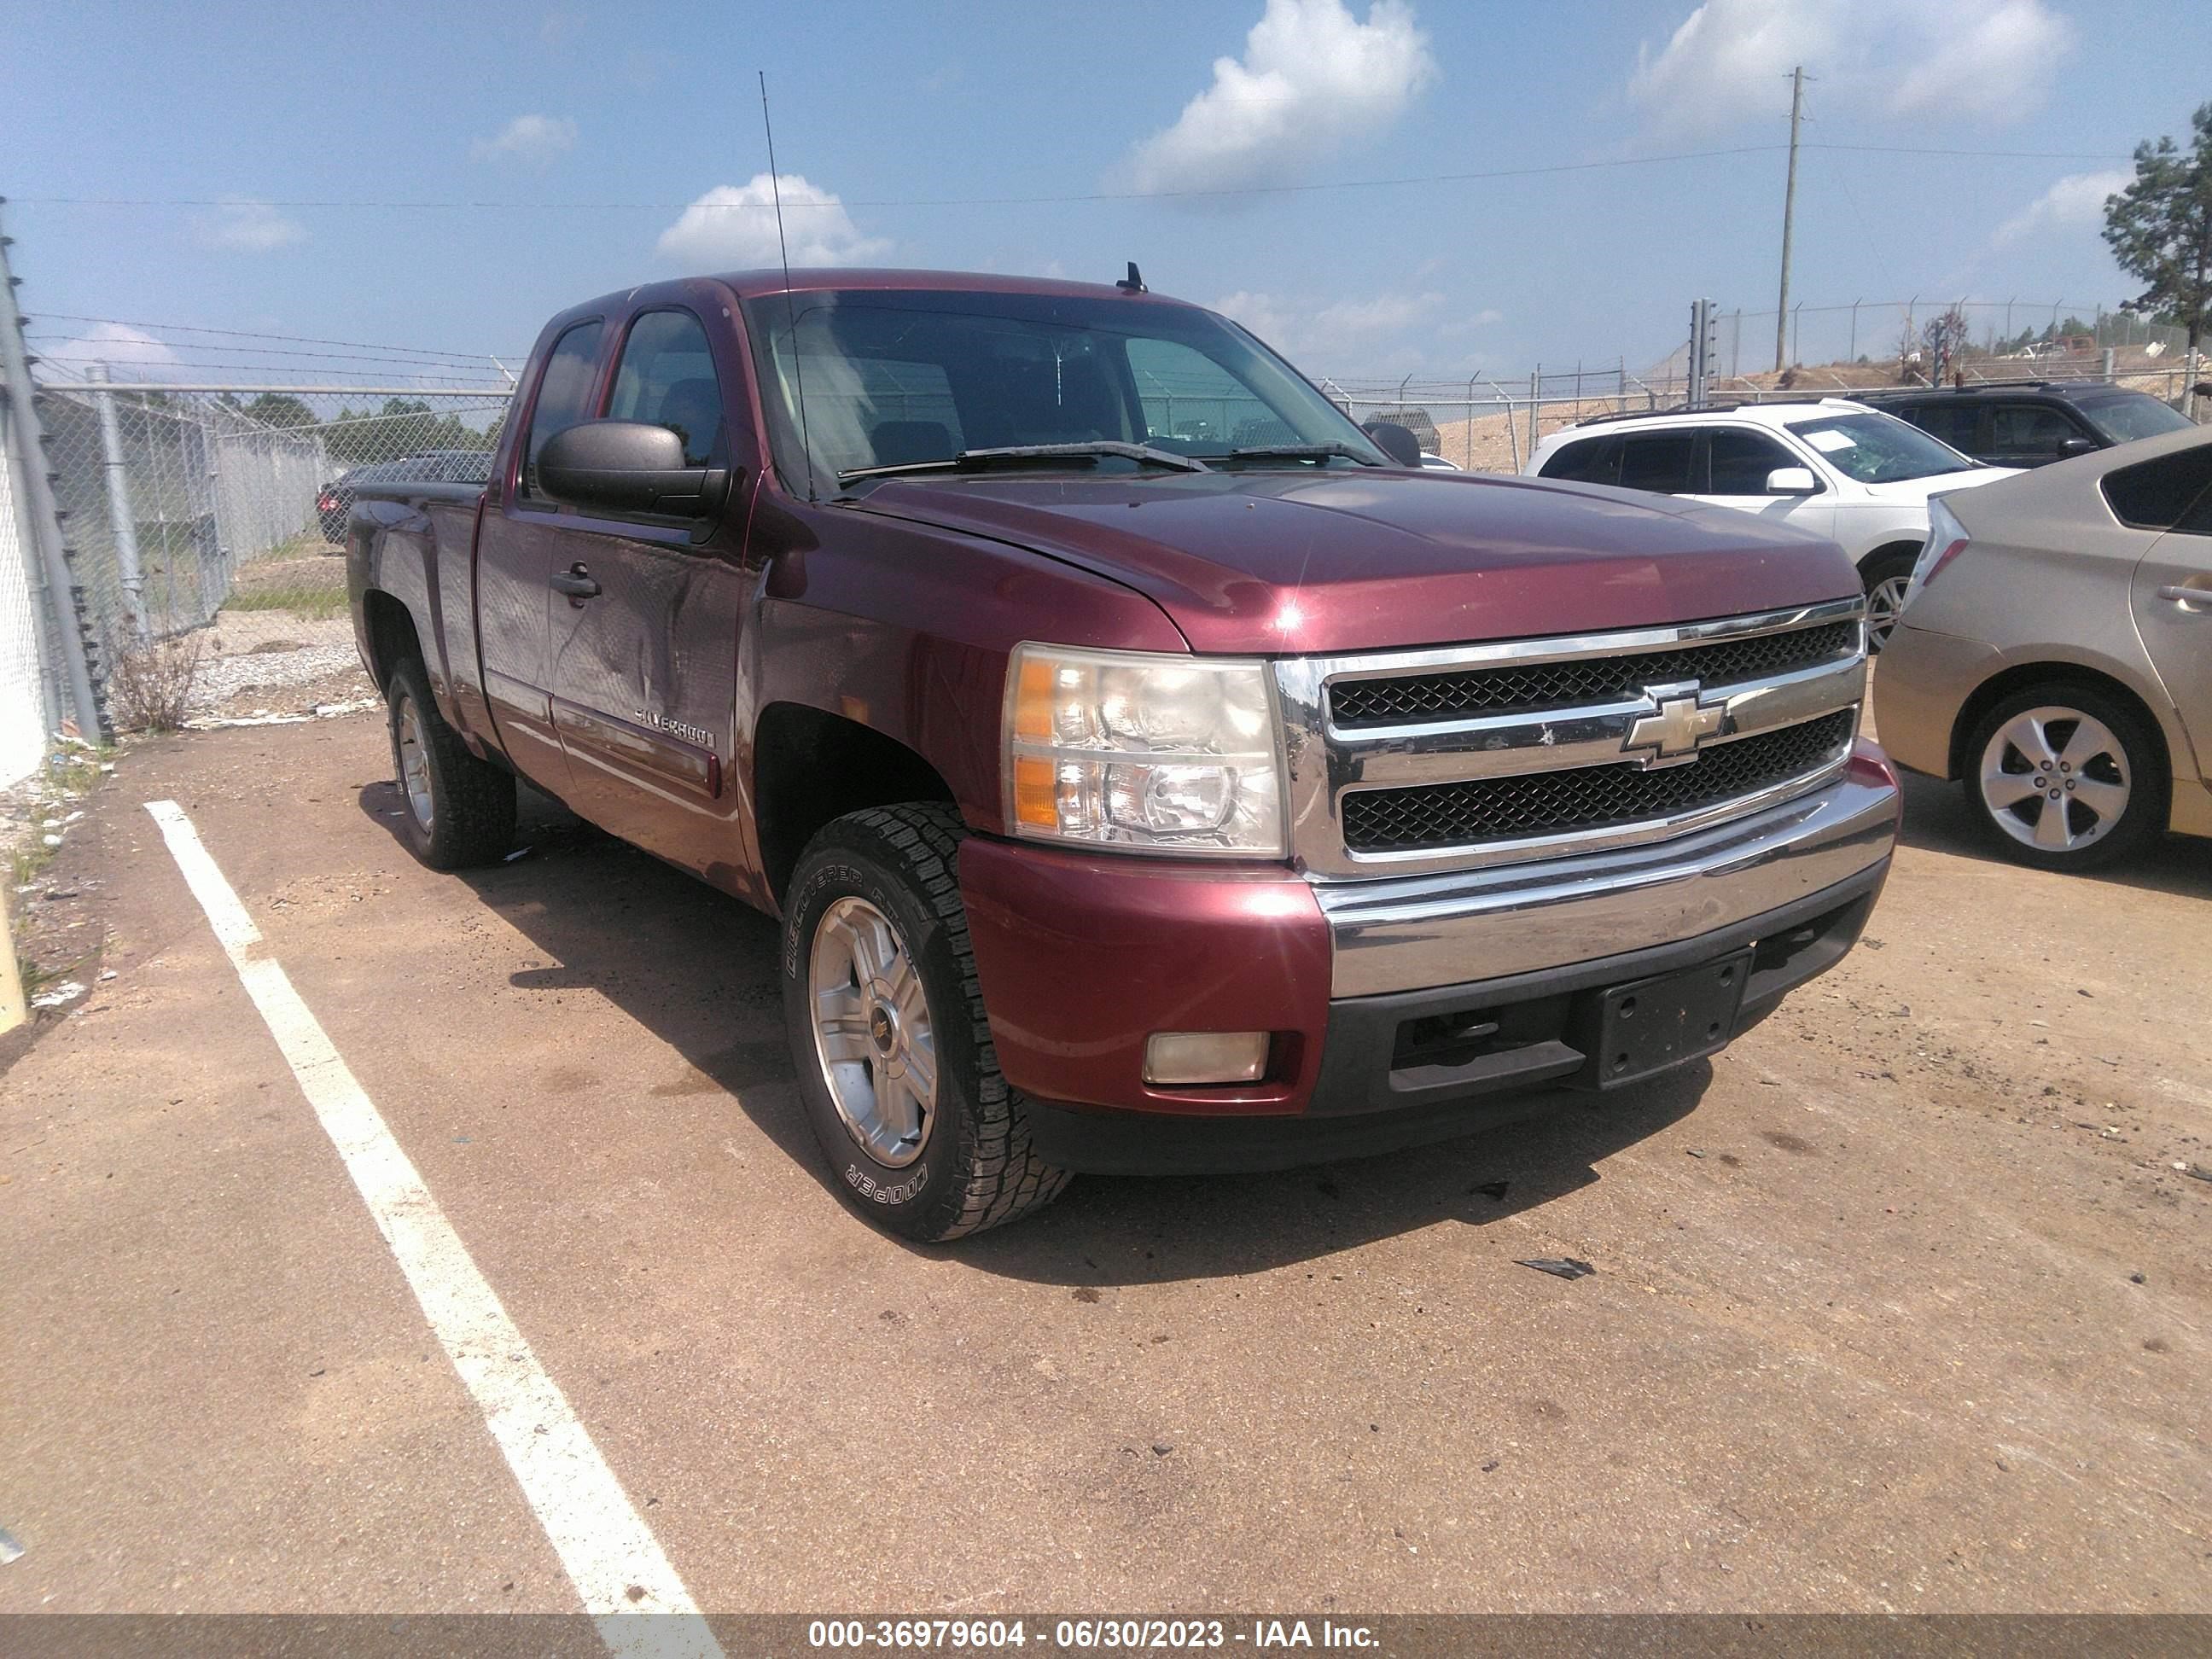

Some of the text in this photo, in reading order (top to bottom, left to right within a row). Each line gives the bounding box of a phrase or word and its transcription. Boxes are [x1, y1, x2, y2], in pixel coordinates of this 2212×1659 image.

[634, 707, 707, 744] SILVERADO
[785, 864, 864, 980] DISCOVERER
[845, 1163, 928, 1205] COOPER
